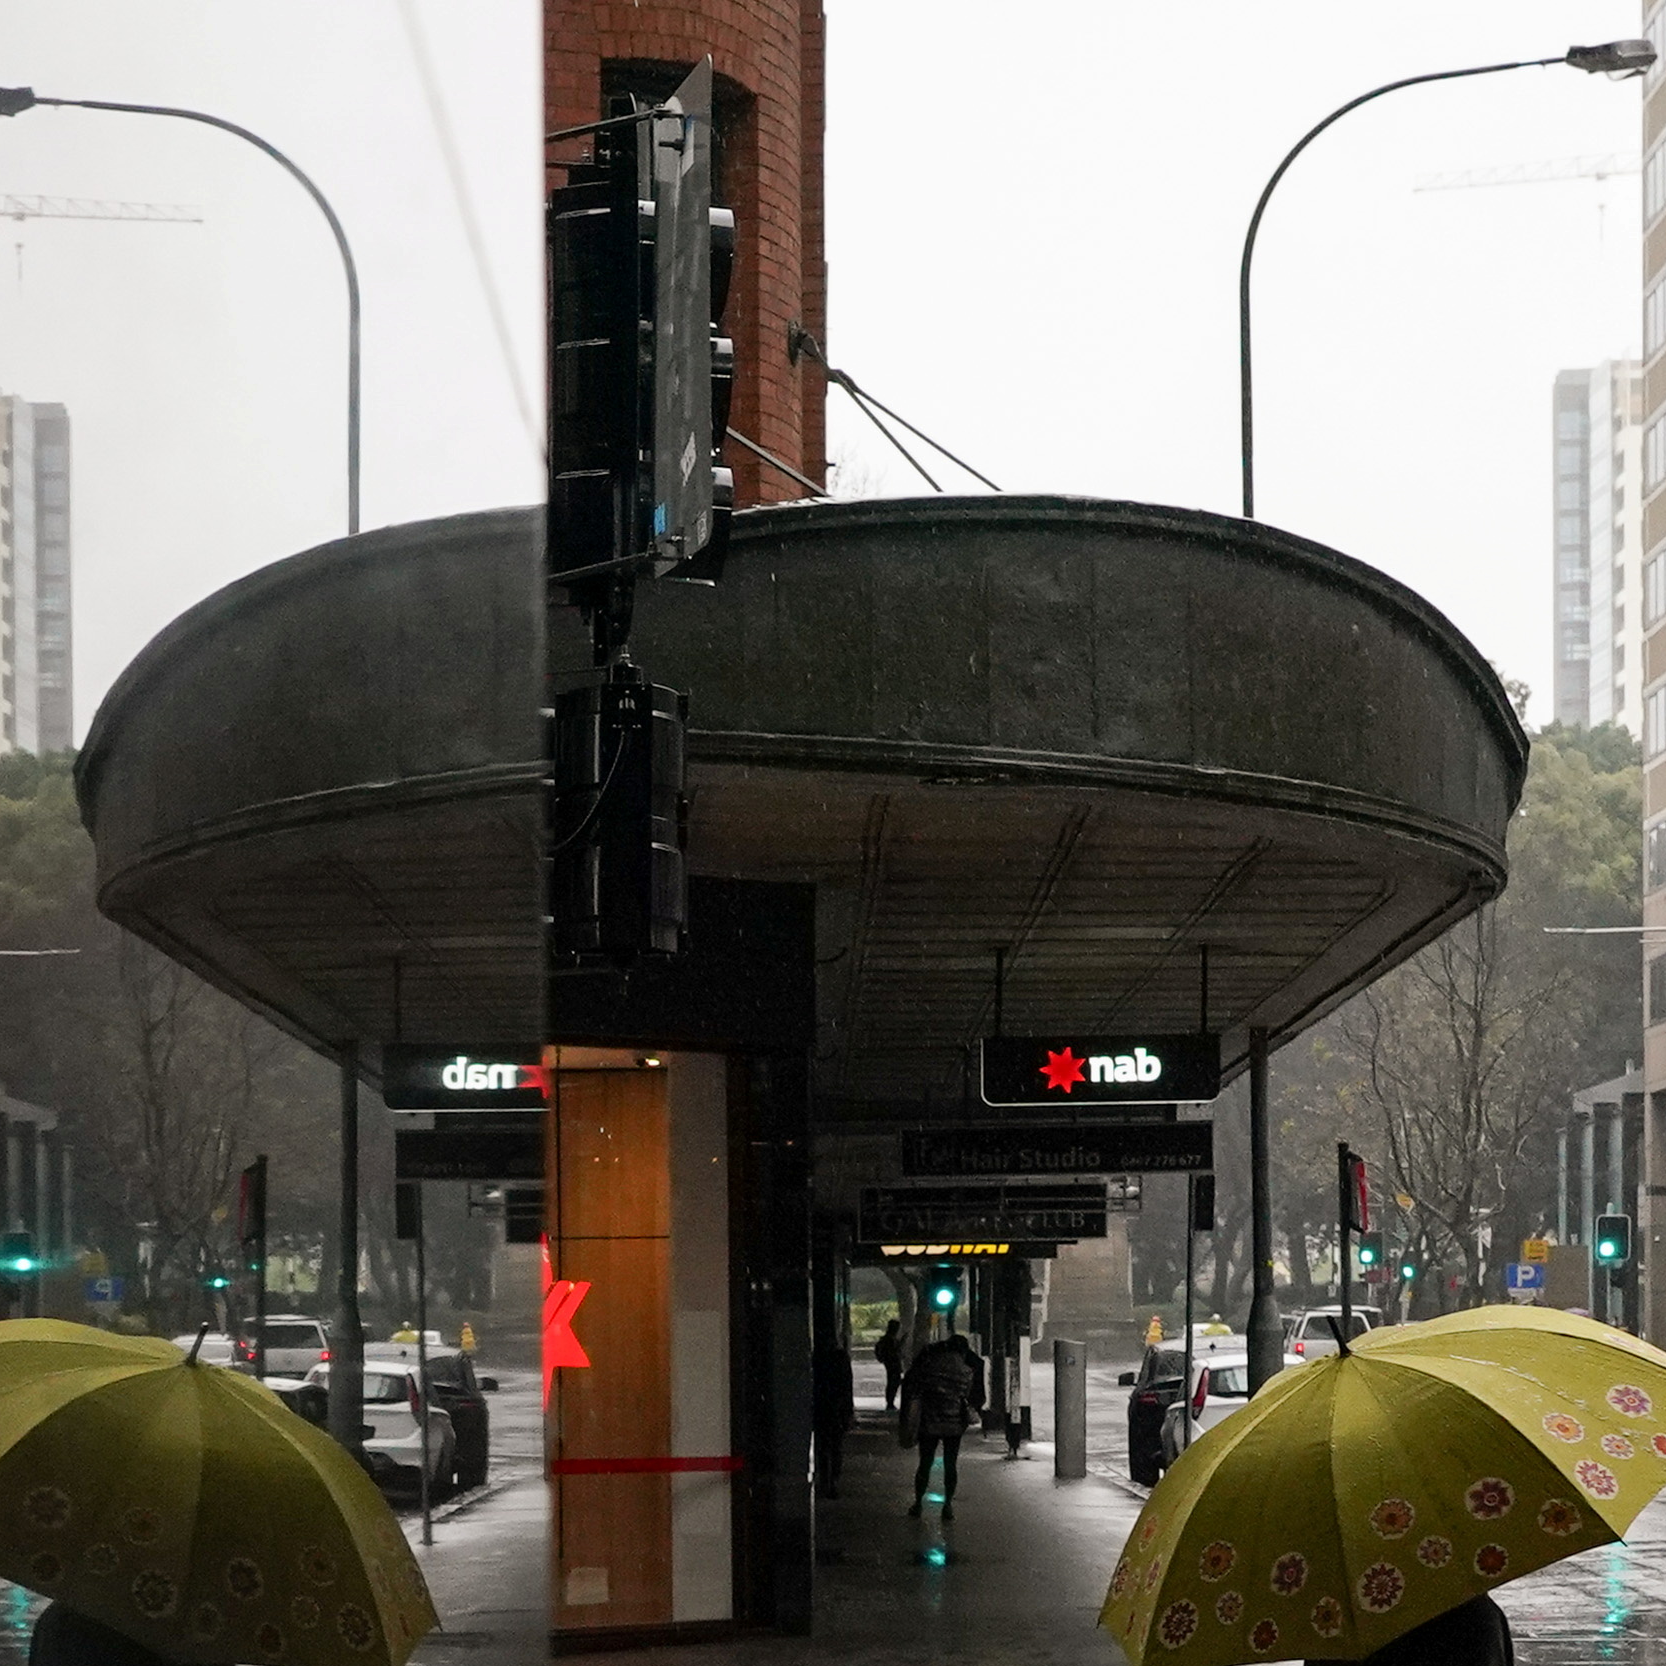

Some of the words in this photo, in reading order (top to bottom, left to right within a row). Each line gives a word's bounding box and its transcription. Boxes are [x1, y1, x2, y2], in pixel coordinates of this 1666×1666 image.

[1089, 1048, 1162, 1083] nab
[960, 1146, 1012, 1169] Hair
[1019, 1145, 1101, 1169] Studio
[1517, 1266, 1535, 1287] P
